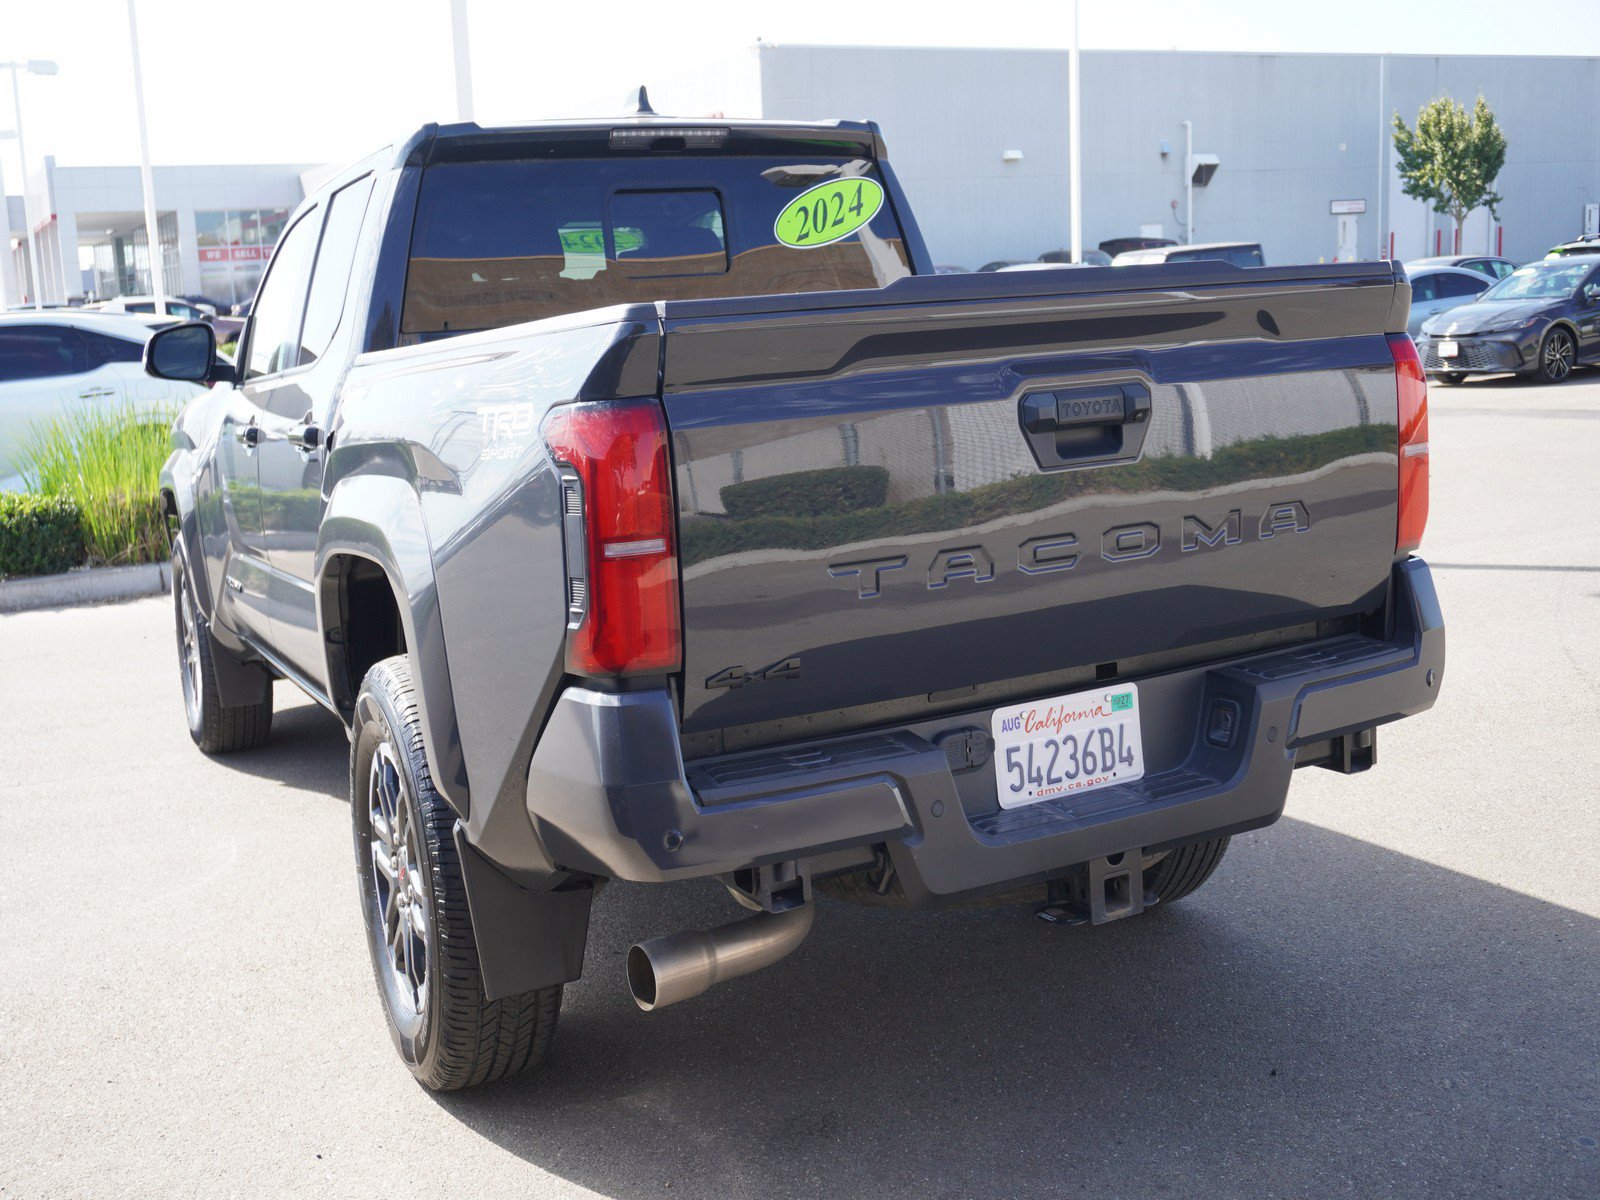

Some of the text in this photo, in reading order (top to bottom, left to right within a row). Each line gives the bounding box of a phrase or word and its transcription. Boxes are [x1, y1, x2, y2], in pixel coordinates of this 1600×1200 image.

[795, 182, 864, 242] 2024
[206, 250, 222, 260] WE
[234, 249, 257, 259] SELL
[1061, 398, 1121, 418] TOYOTA
[476, 403, 534, 440] TRD
[481, 445, 524, 461] SPORT
[827, 499, 1311, 599] TACOMA
[1001, 716, 1021, 733] AUG
[1024, 704, 1112, 734] California
[1006, 723, 1134, 792] 54236B4
[1036, 775, 1110, 797] dmv.ca.gov
